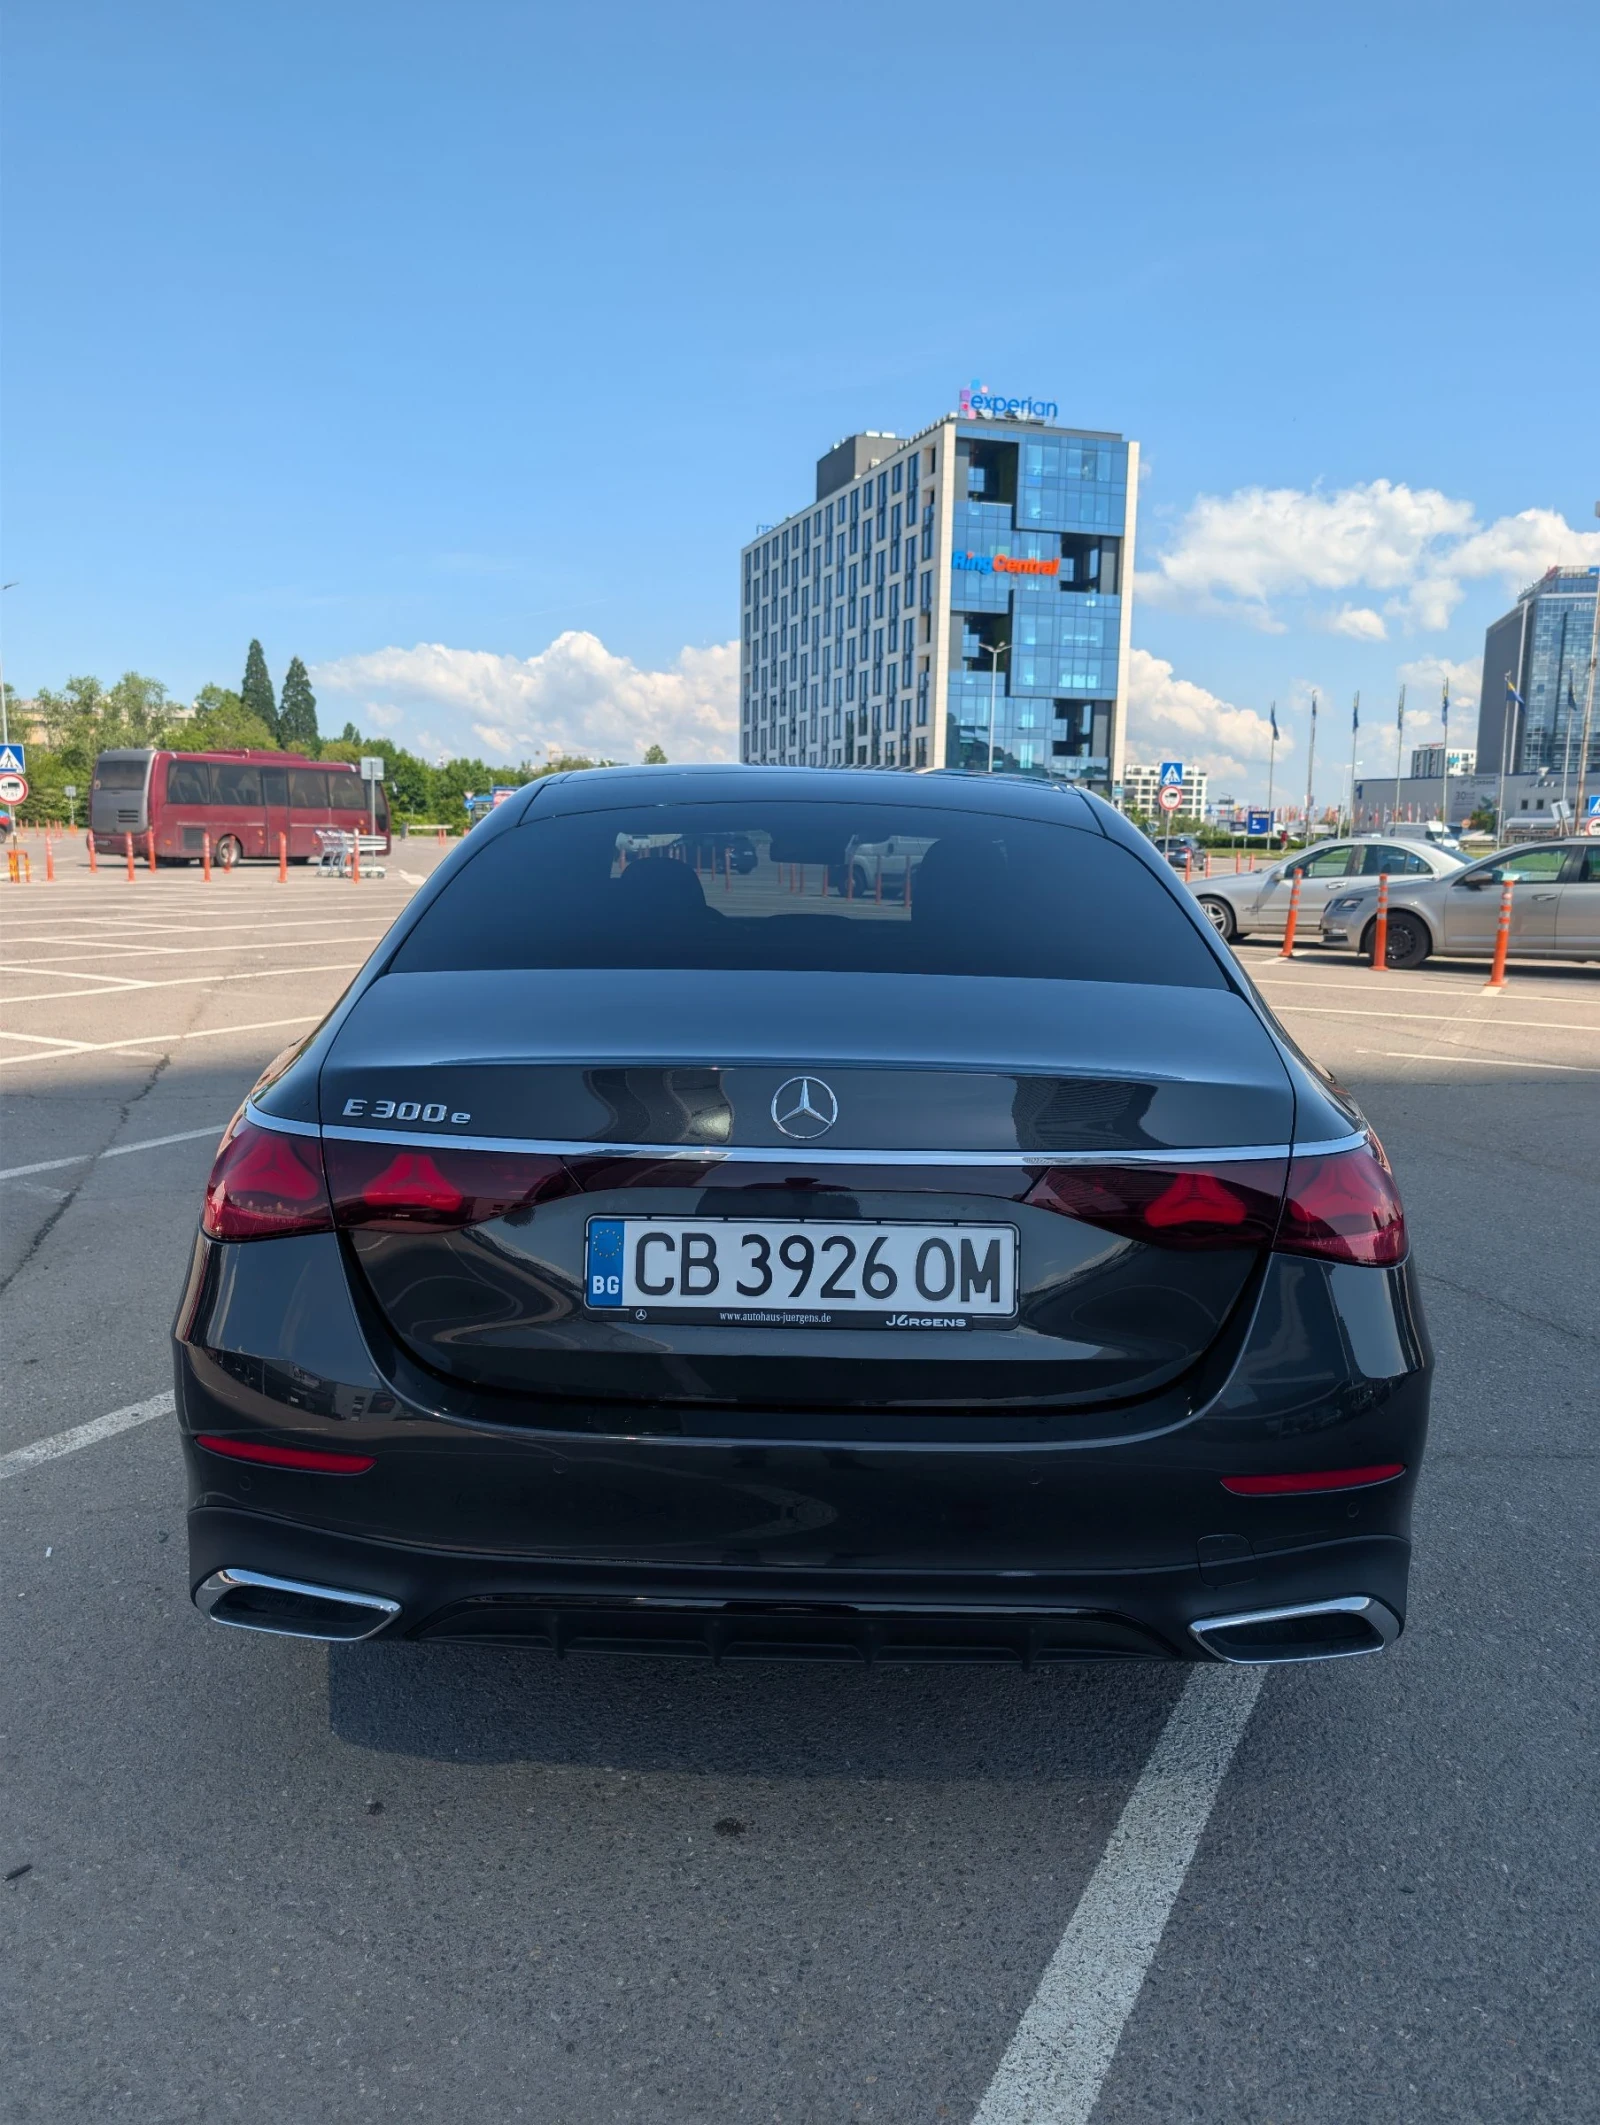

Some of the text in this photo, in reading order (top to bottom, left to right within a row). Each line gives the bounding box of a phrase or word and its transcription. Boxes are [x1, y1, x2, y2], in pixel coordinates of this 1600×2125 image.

[970, 394, 1058, 417] experian
[953, 551, 1060, 576] RingCentral
[342, 1098, 368, 1117] E
[635, 1232, 1001, 1303] CB 3926 OM
[592, 1275, 620, 1295] BG
[719, 1311, 832, 1325] www.autohaus-juergens.de
